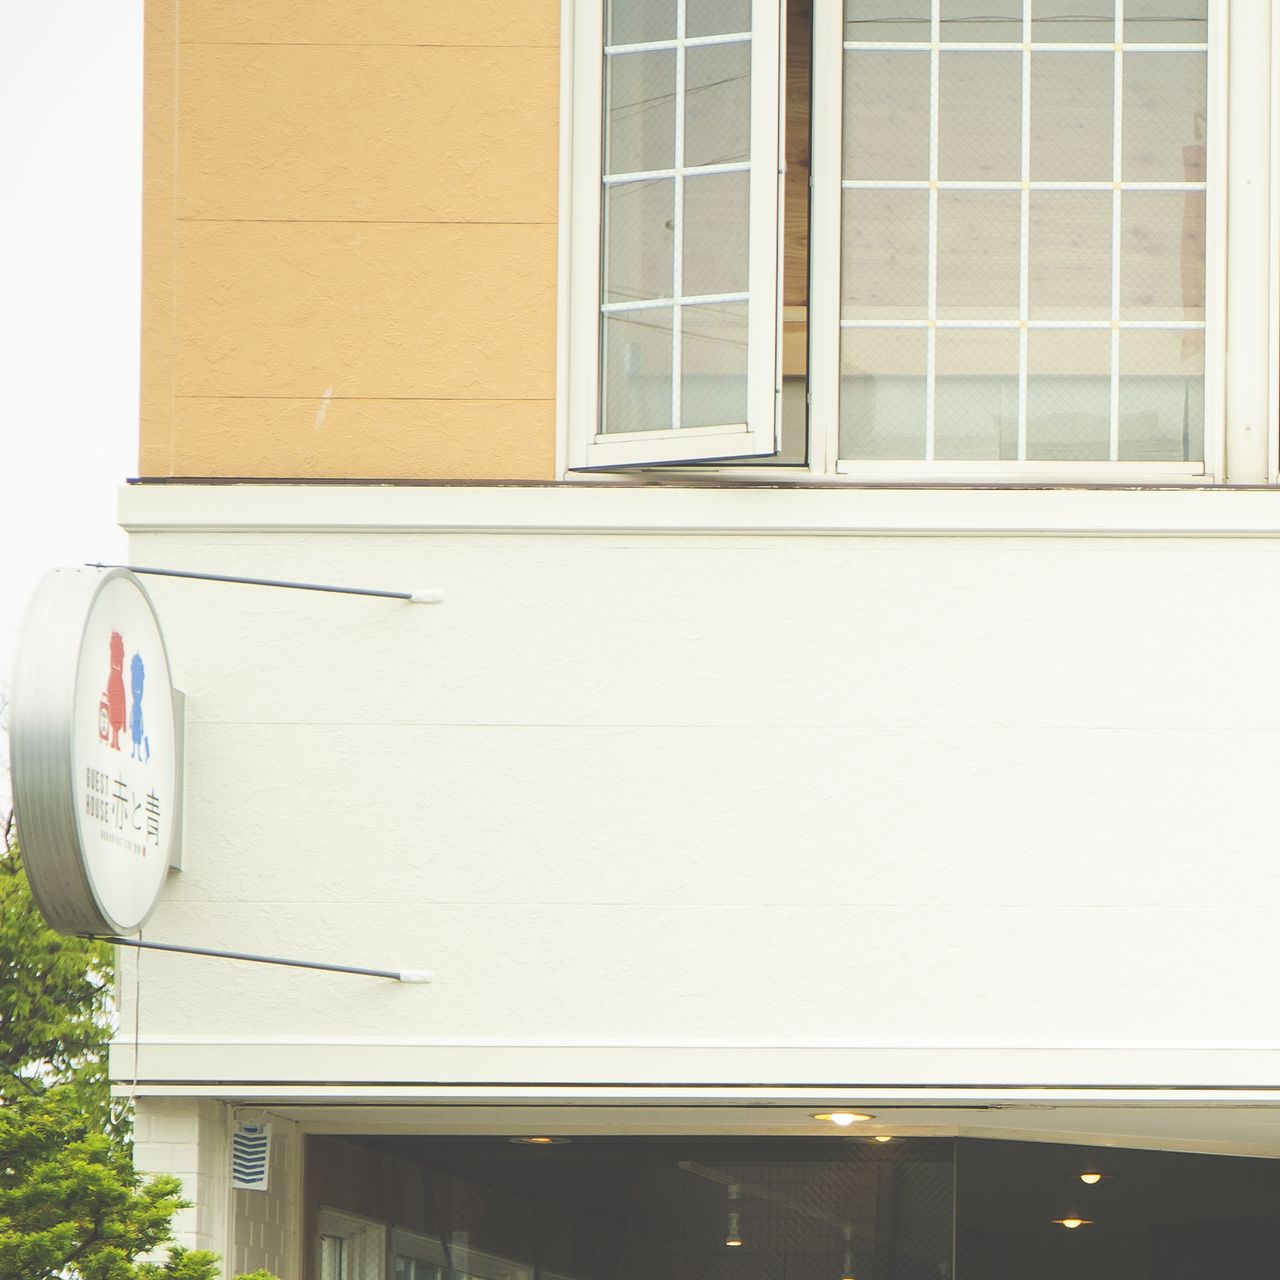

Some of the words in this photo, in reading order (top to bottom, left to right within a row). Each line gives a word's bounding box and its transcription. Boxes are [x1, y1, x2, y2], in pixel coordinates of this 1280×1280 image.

[86, 767, 109, 796] GUEST
[86, 793, 109, 823] HOUSE
[112, 771, 161, 847] 赤と青
